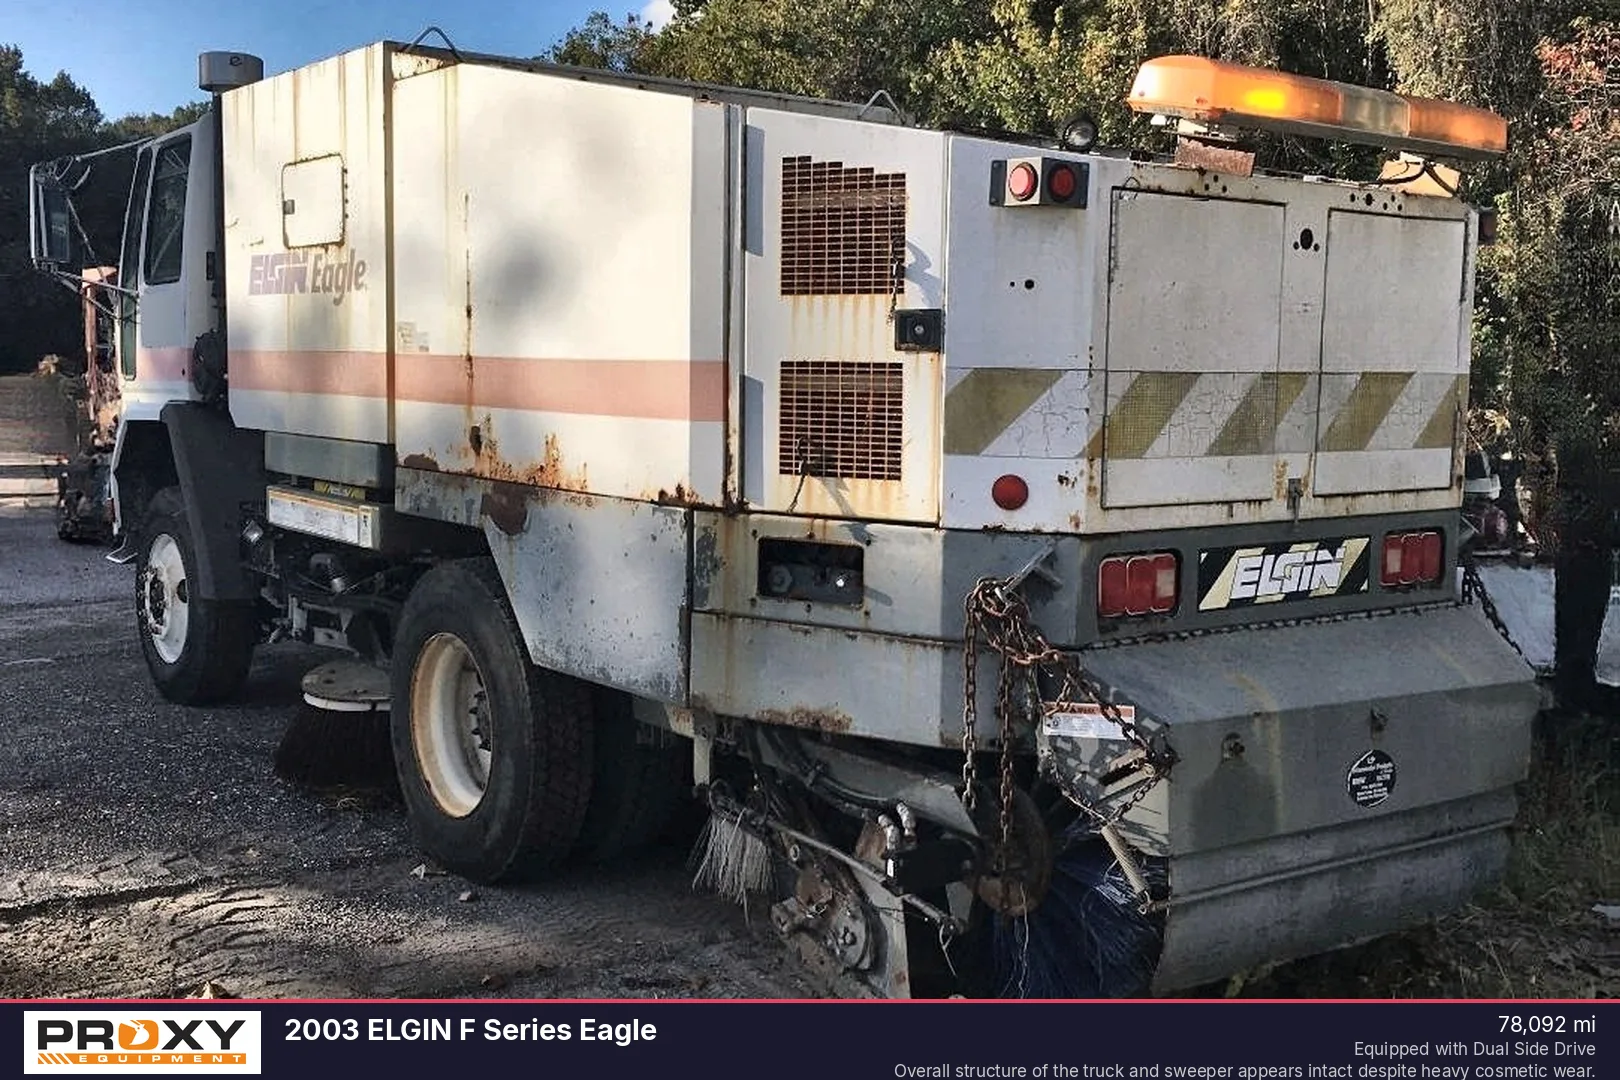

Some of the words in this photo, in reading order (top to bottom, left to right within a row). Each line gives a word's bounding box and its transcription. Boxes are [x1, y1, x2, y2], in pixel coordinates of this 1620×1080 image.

[249, 252, 308, 295] ELGIN
[311, 248, 366, 306] Eagle
[1230, 546, 1345, 600] ELGIN
